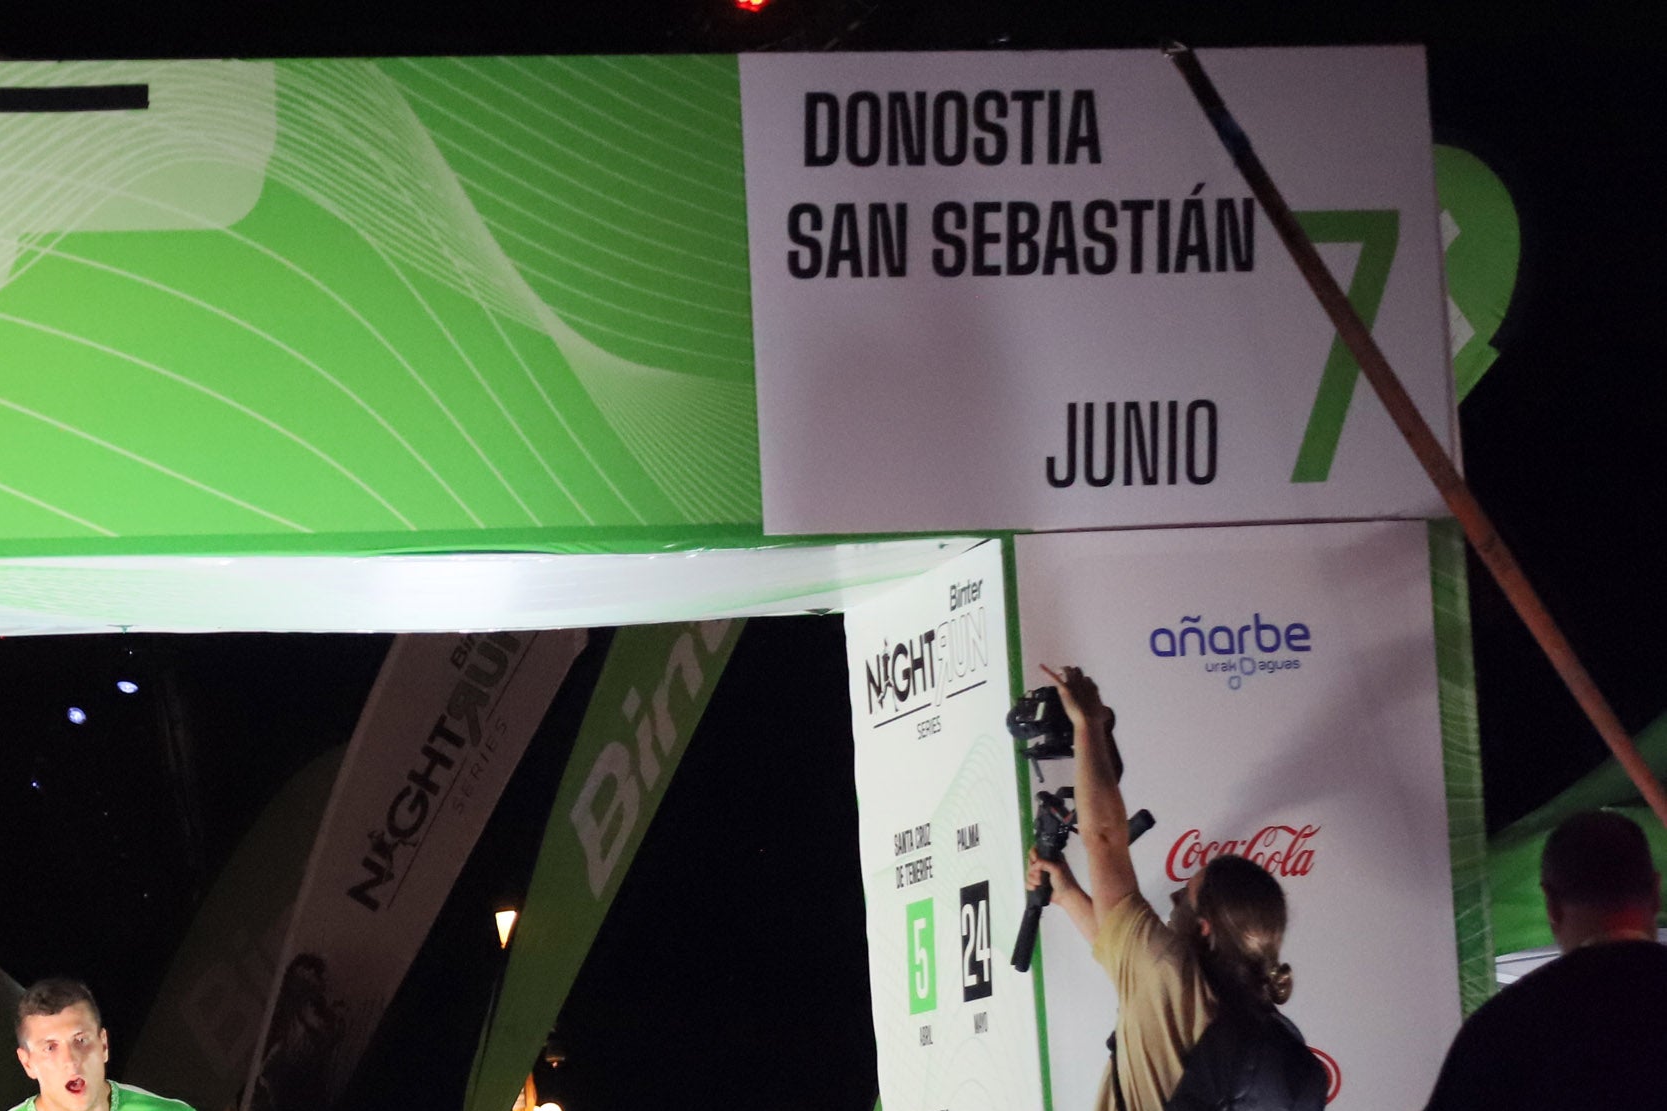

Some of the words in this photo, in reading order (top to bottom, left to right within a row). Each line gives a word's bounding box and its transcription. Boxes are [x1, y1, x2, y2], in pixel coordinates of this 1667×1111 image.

[803, 89, 1103, 167] DONOSTIA
[787, 203, 908, 280] SAN
[932, 184, 1255, 277] SEBASTIÁN
[1288, 209, 1401, 484] 7
[1045, 399, 1219, 488] JUNIO
[950, 578, 983, 612] Binter
[1149, 613, 1312, 657] añarbe
[1205, 660, 1237, 673] urak
[1258, 658, 1301, 673] aguas
[570, 619, 731, 900] Bin
[913, 917, 929, 1001] 5
[960, 899, 992, 989] 24
